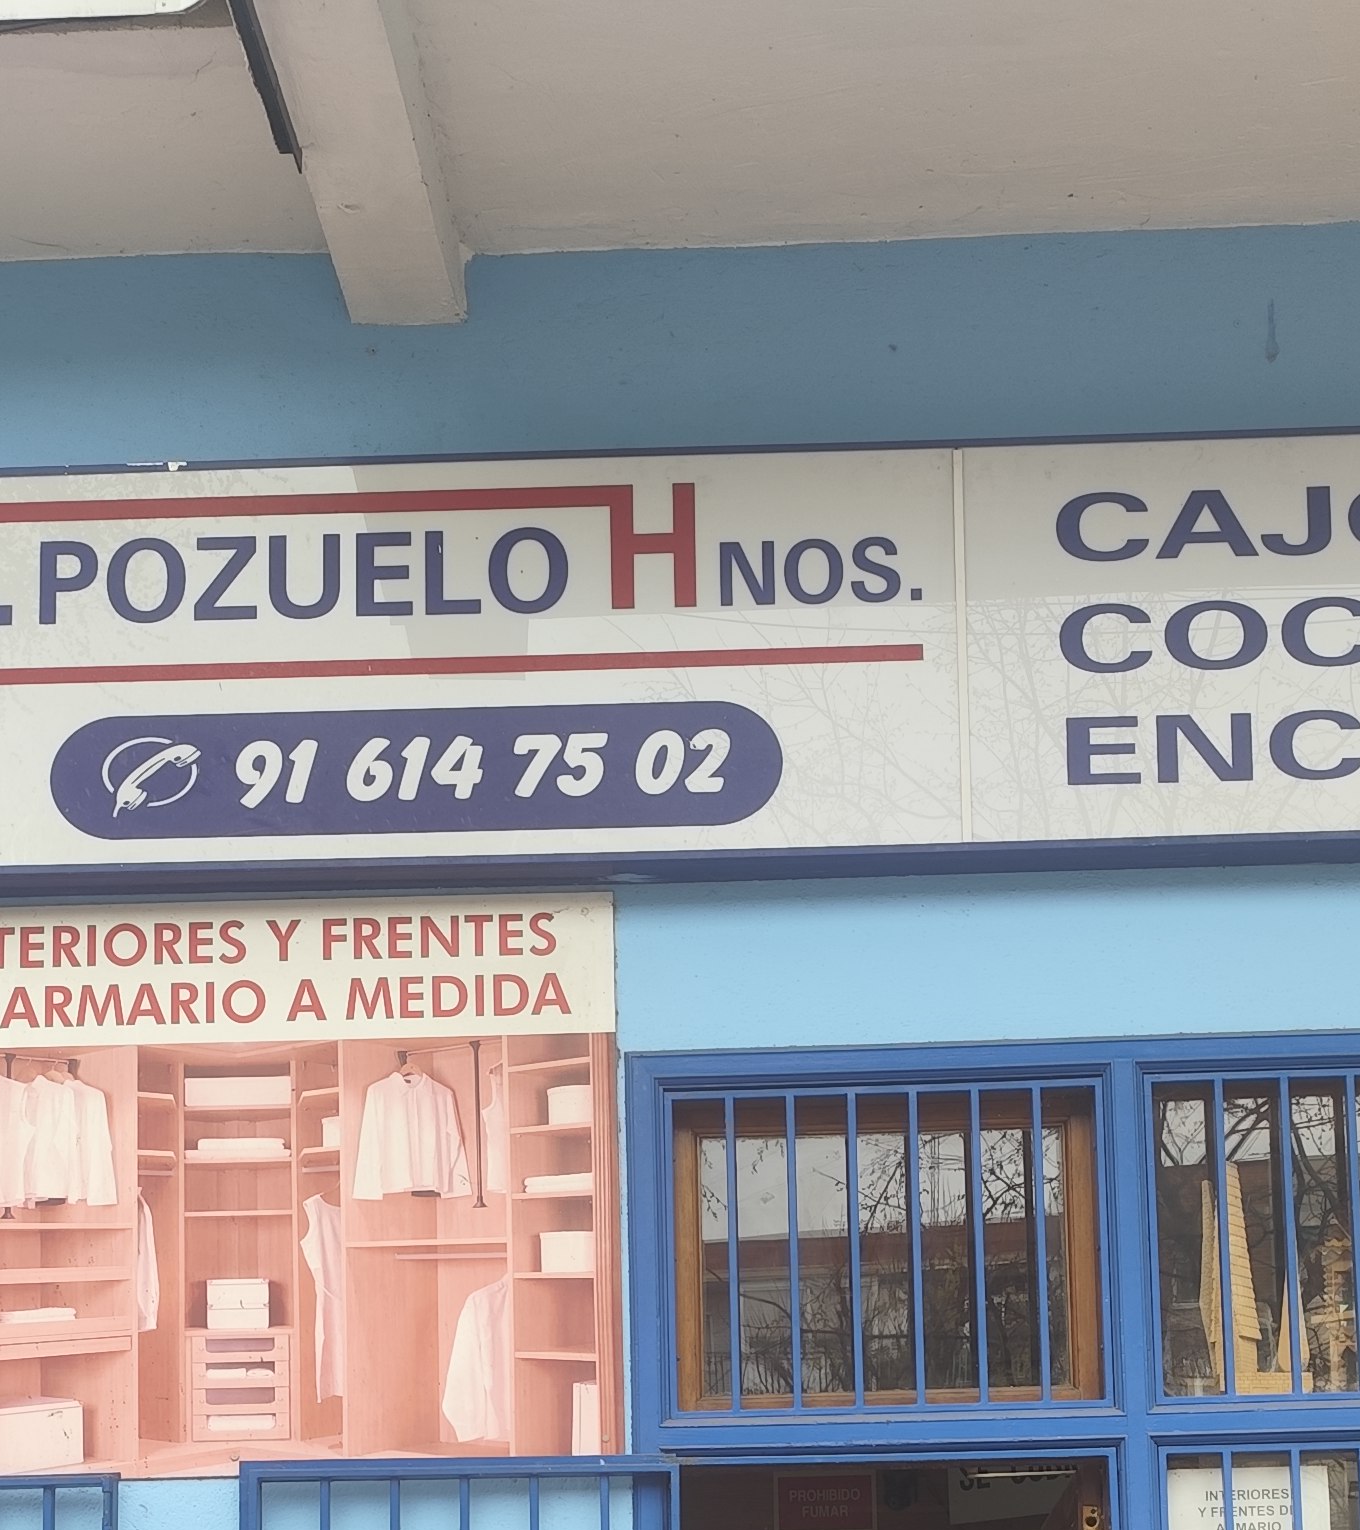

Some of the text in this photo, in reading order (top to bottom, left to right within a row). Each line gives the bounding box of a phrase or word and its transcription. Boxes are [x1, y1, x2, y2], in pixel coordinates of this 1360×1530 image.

[234, 728, 732, 809] 91 614 75 02
[266, 920, 299, 963] Y
[322, 912, 558, 962] FRENTES
[0, 979, 267, 1030] ARMARIO
[286, 978, 327, 1022] A
[345, 972, 572, 1020] MEDIDA
[789, 1489, 861, 1502] PROHIBIDO
[802, 1505, 849, 1518] FUMAR
[1198, 1507, 1206, 1517] Y
[1280, 1505, 1293, 1516] D
